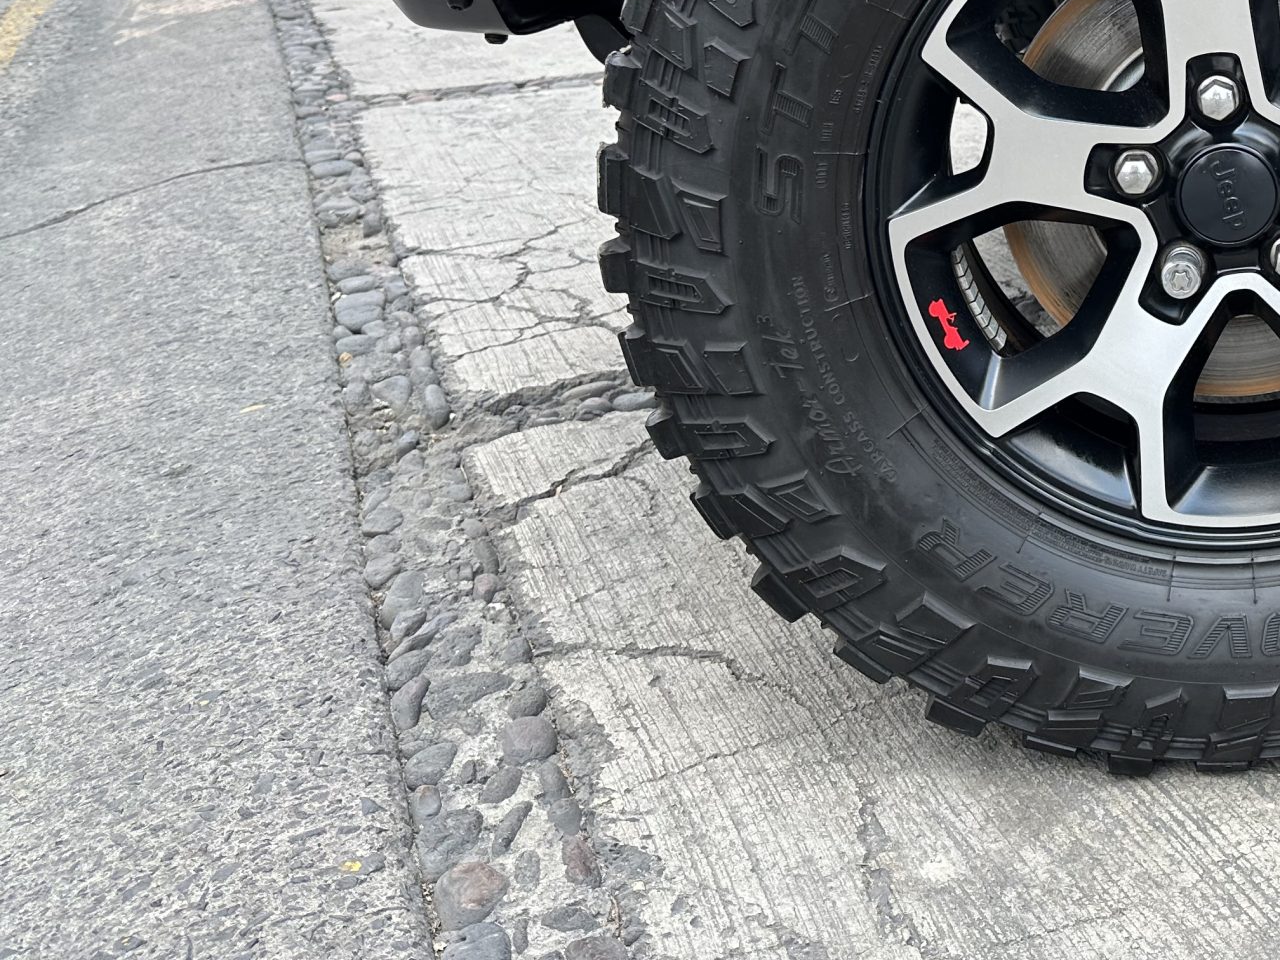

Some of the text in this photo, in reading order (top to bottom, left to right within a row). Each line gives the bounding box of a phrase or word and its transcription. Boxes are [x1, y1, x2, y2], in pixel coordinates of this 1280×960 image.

[1210, 160, 1248, 230] Jeep
[791, 275, 847, 405] CONSTRUCTION
[843, 409, 899, 484] CARCASS
